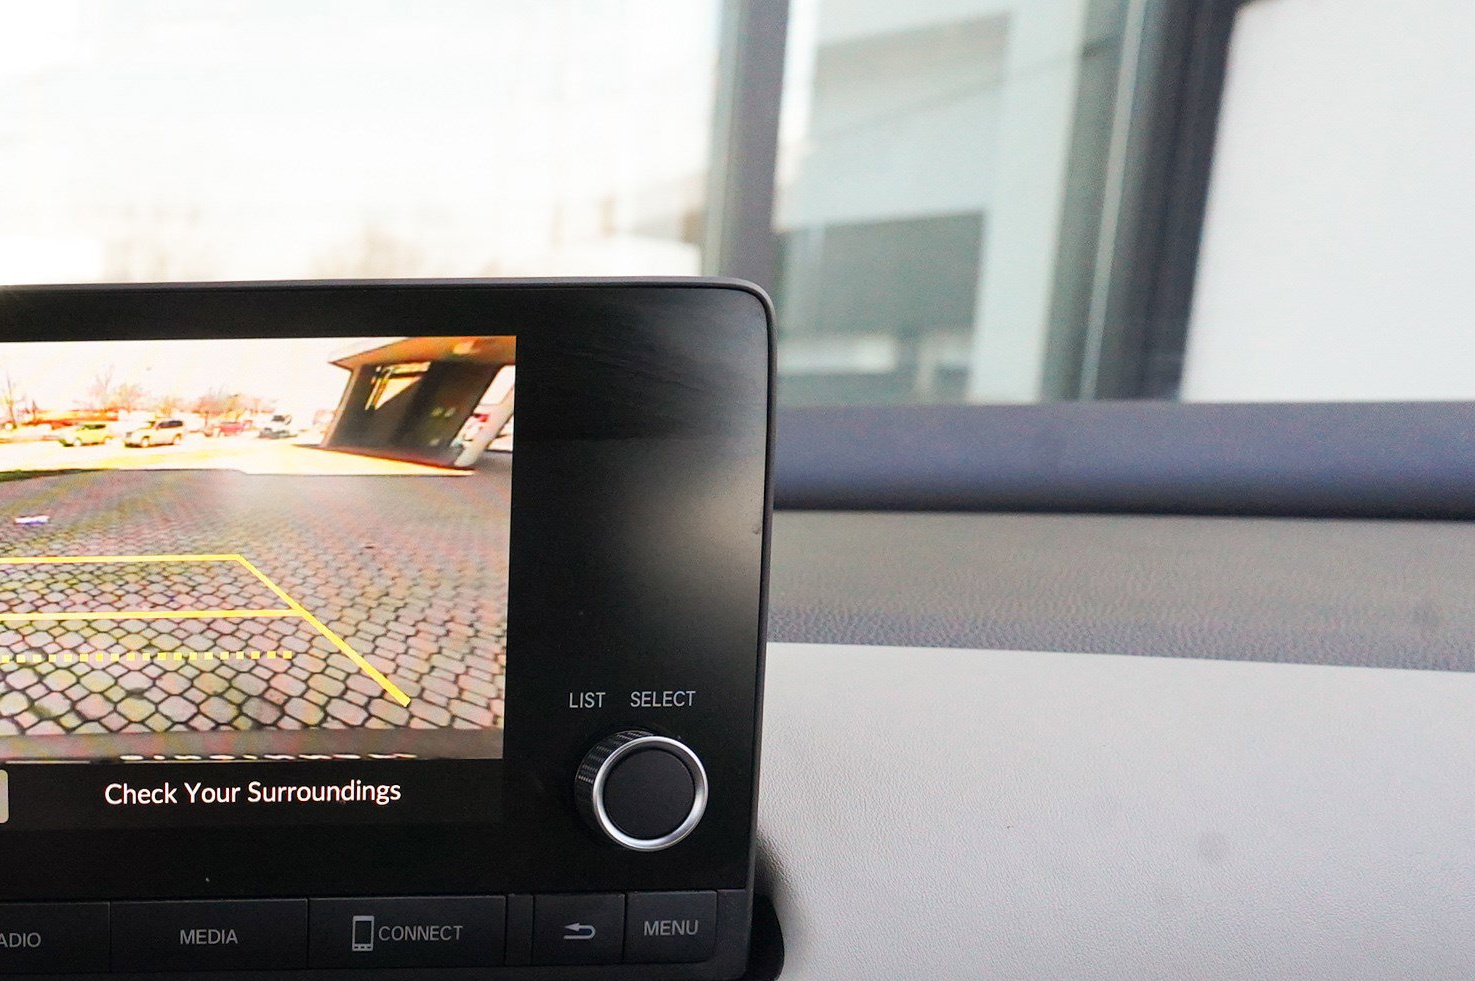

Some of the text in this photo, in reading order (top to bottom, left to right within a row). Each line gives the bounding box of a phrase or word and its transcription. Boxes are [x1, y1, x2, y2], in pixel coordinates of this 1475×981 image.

[570, 691, 696, 708] LIST SELECT
[105, 779, 402, 806] Check Your Surroundings
[378, 925, 464, 942] CONNECT
[644, 919, 698, 936] MENU
[179, 928, 239, 945] MEDIA
